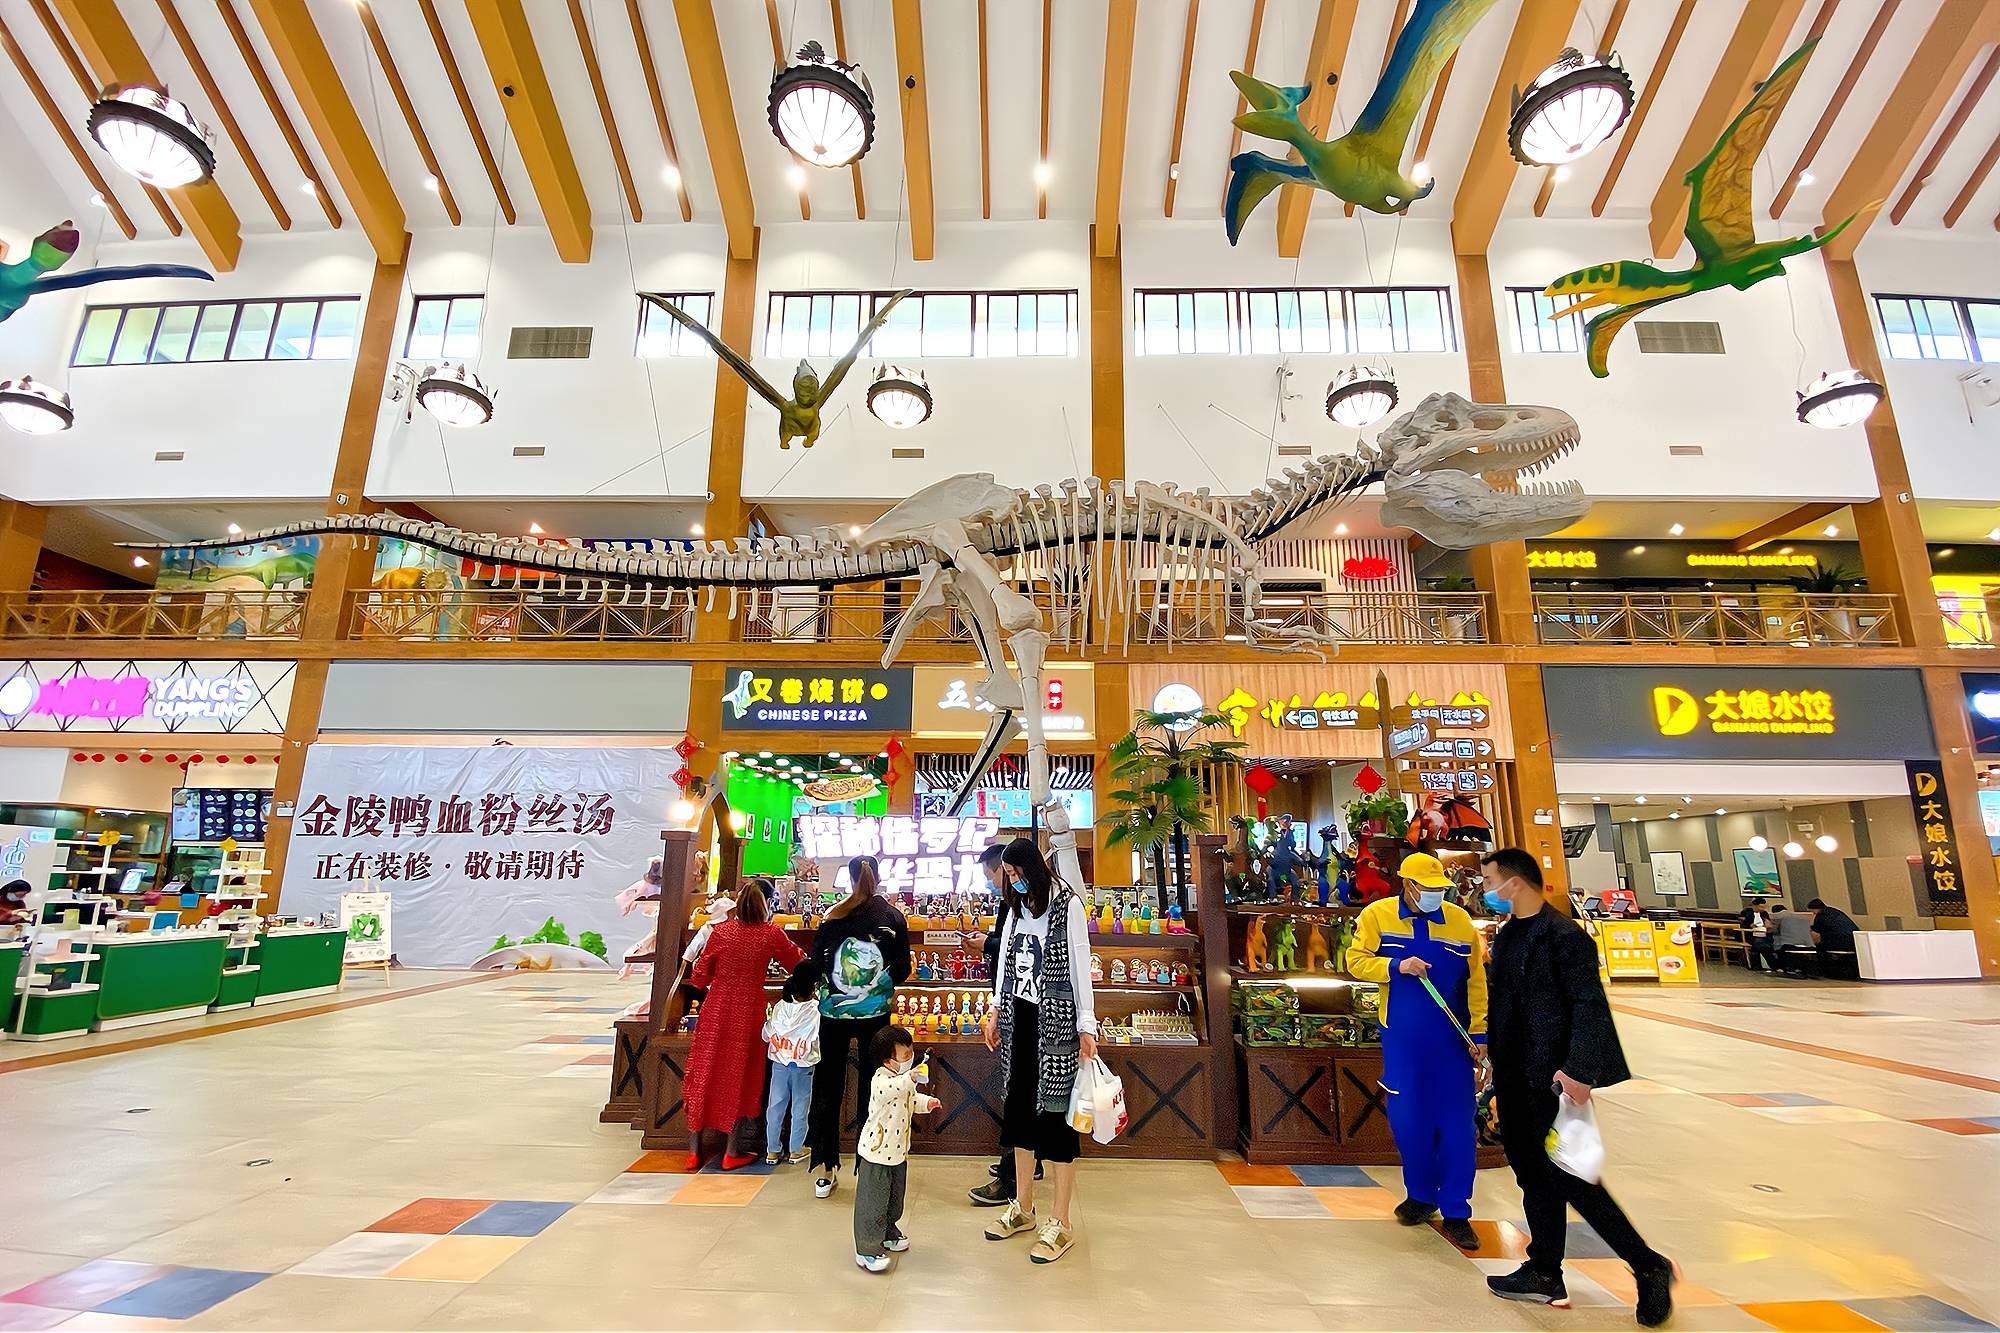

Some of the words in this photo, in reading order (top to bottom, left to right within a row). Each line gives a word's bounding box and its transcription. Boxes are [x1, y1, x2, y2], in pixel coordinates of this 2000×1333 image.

[154, 678, 252, 701] YANG'S
[1704, 689, 1835, 721] 大娘水饺
[153, 701, 248, 717] DUMPLING
[757, 709, 820, 721] CHINESE
[824, 709, 868, 721] PIZZA
[295, 792, 616, 839] 金陵鸭血粉丝汤
[1920, 800, 1957, 891] 大娘水饺
[313, 850, 585, 882] 正在装修·敬请期待
